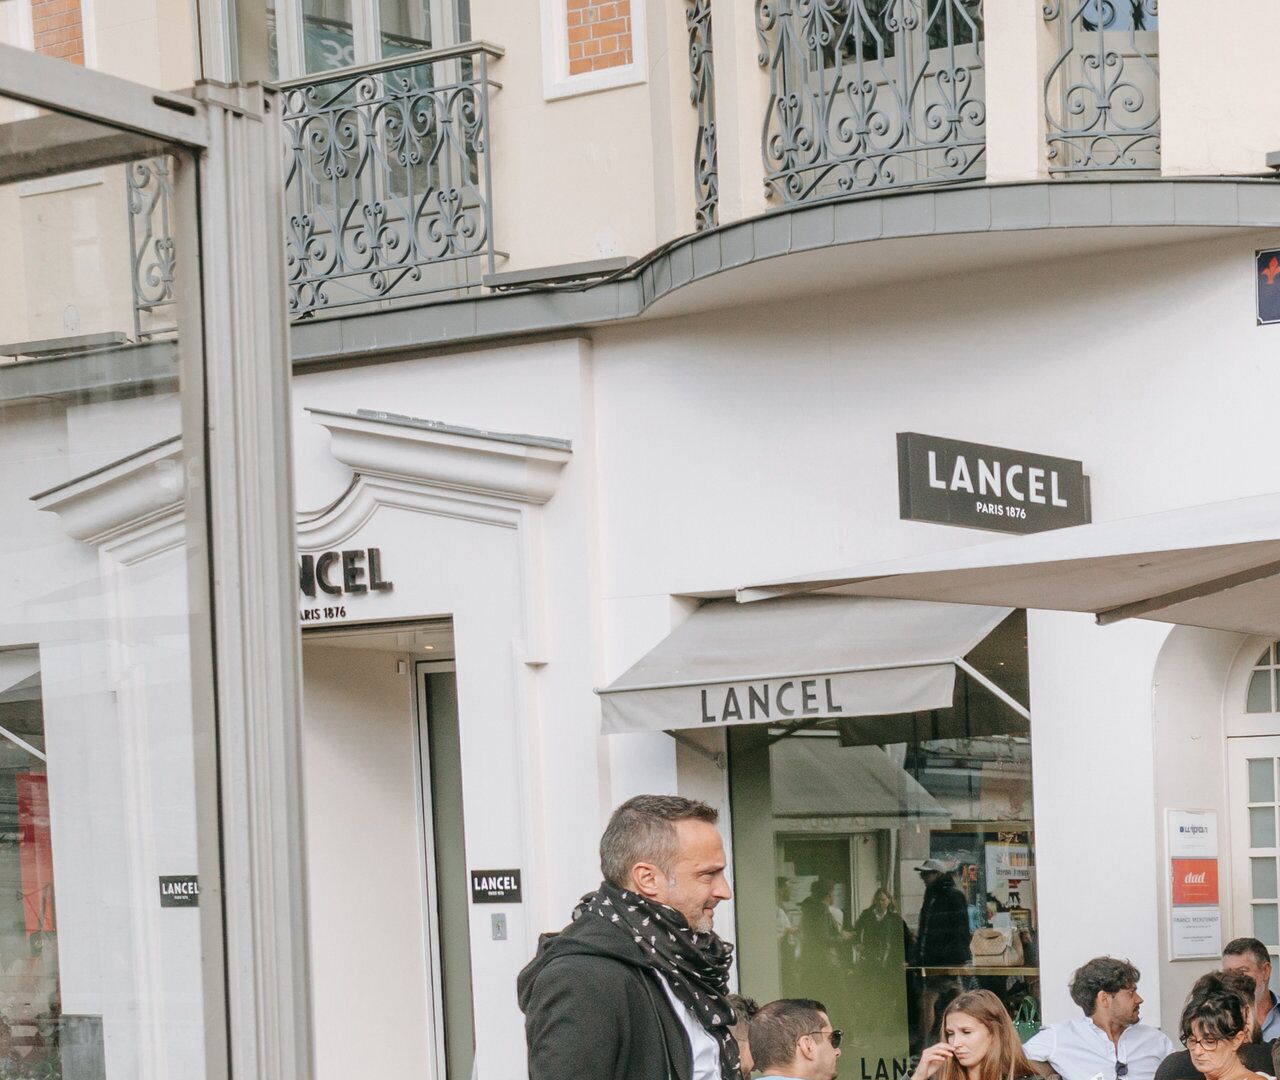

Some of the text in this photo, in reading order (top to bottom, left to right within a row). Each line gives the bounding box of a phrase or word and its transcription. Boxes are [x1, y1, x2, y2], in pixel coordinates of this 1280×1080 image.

[927, 451, 1068, 507] LANCEL
[976, 502, 1027, 519] PARIS 1876
[323, 606, 346, 620] 1876
[701, 678, 843, 723] LANCEL
[474, 876, 518, 890] LANCEL
[1184, 872, 1206, 884] dad
[162, 882, 200, 895] LANCEL
